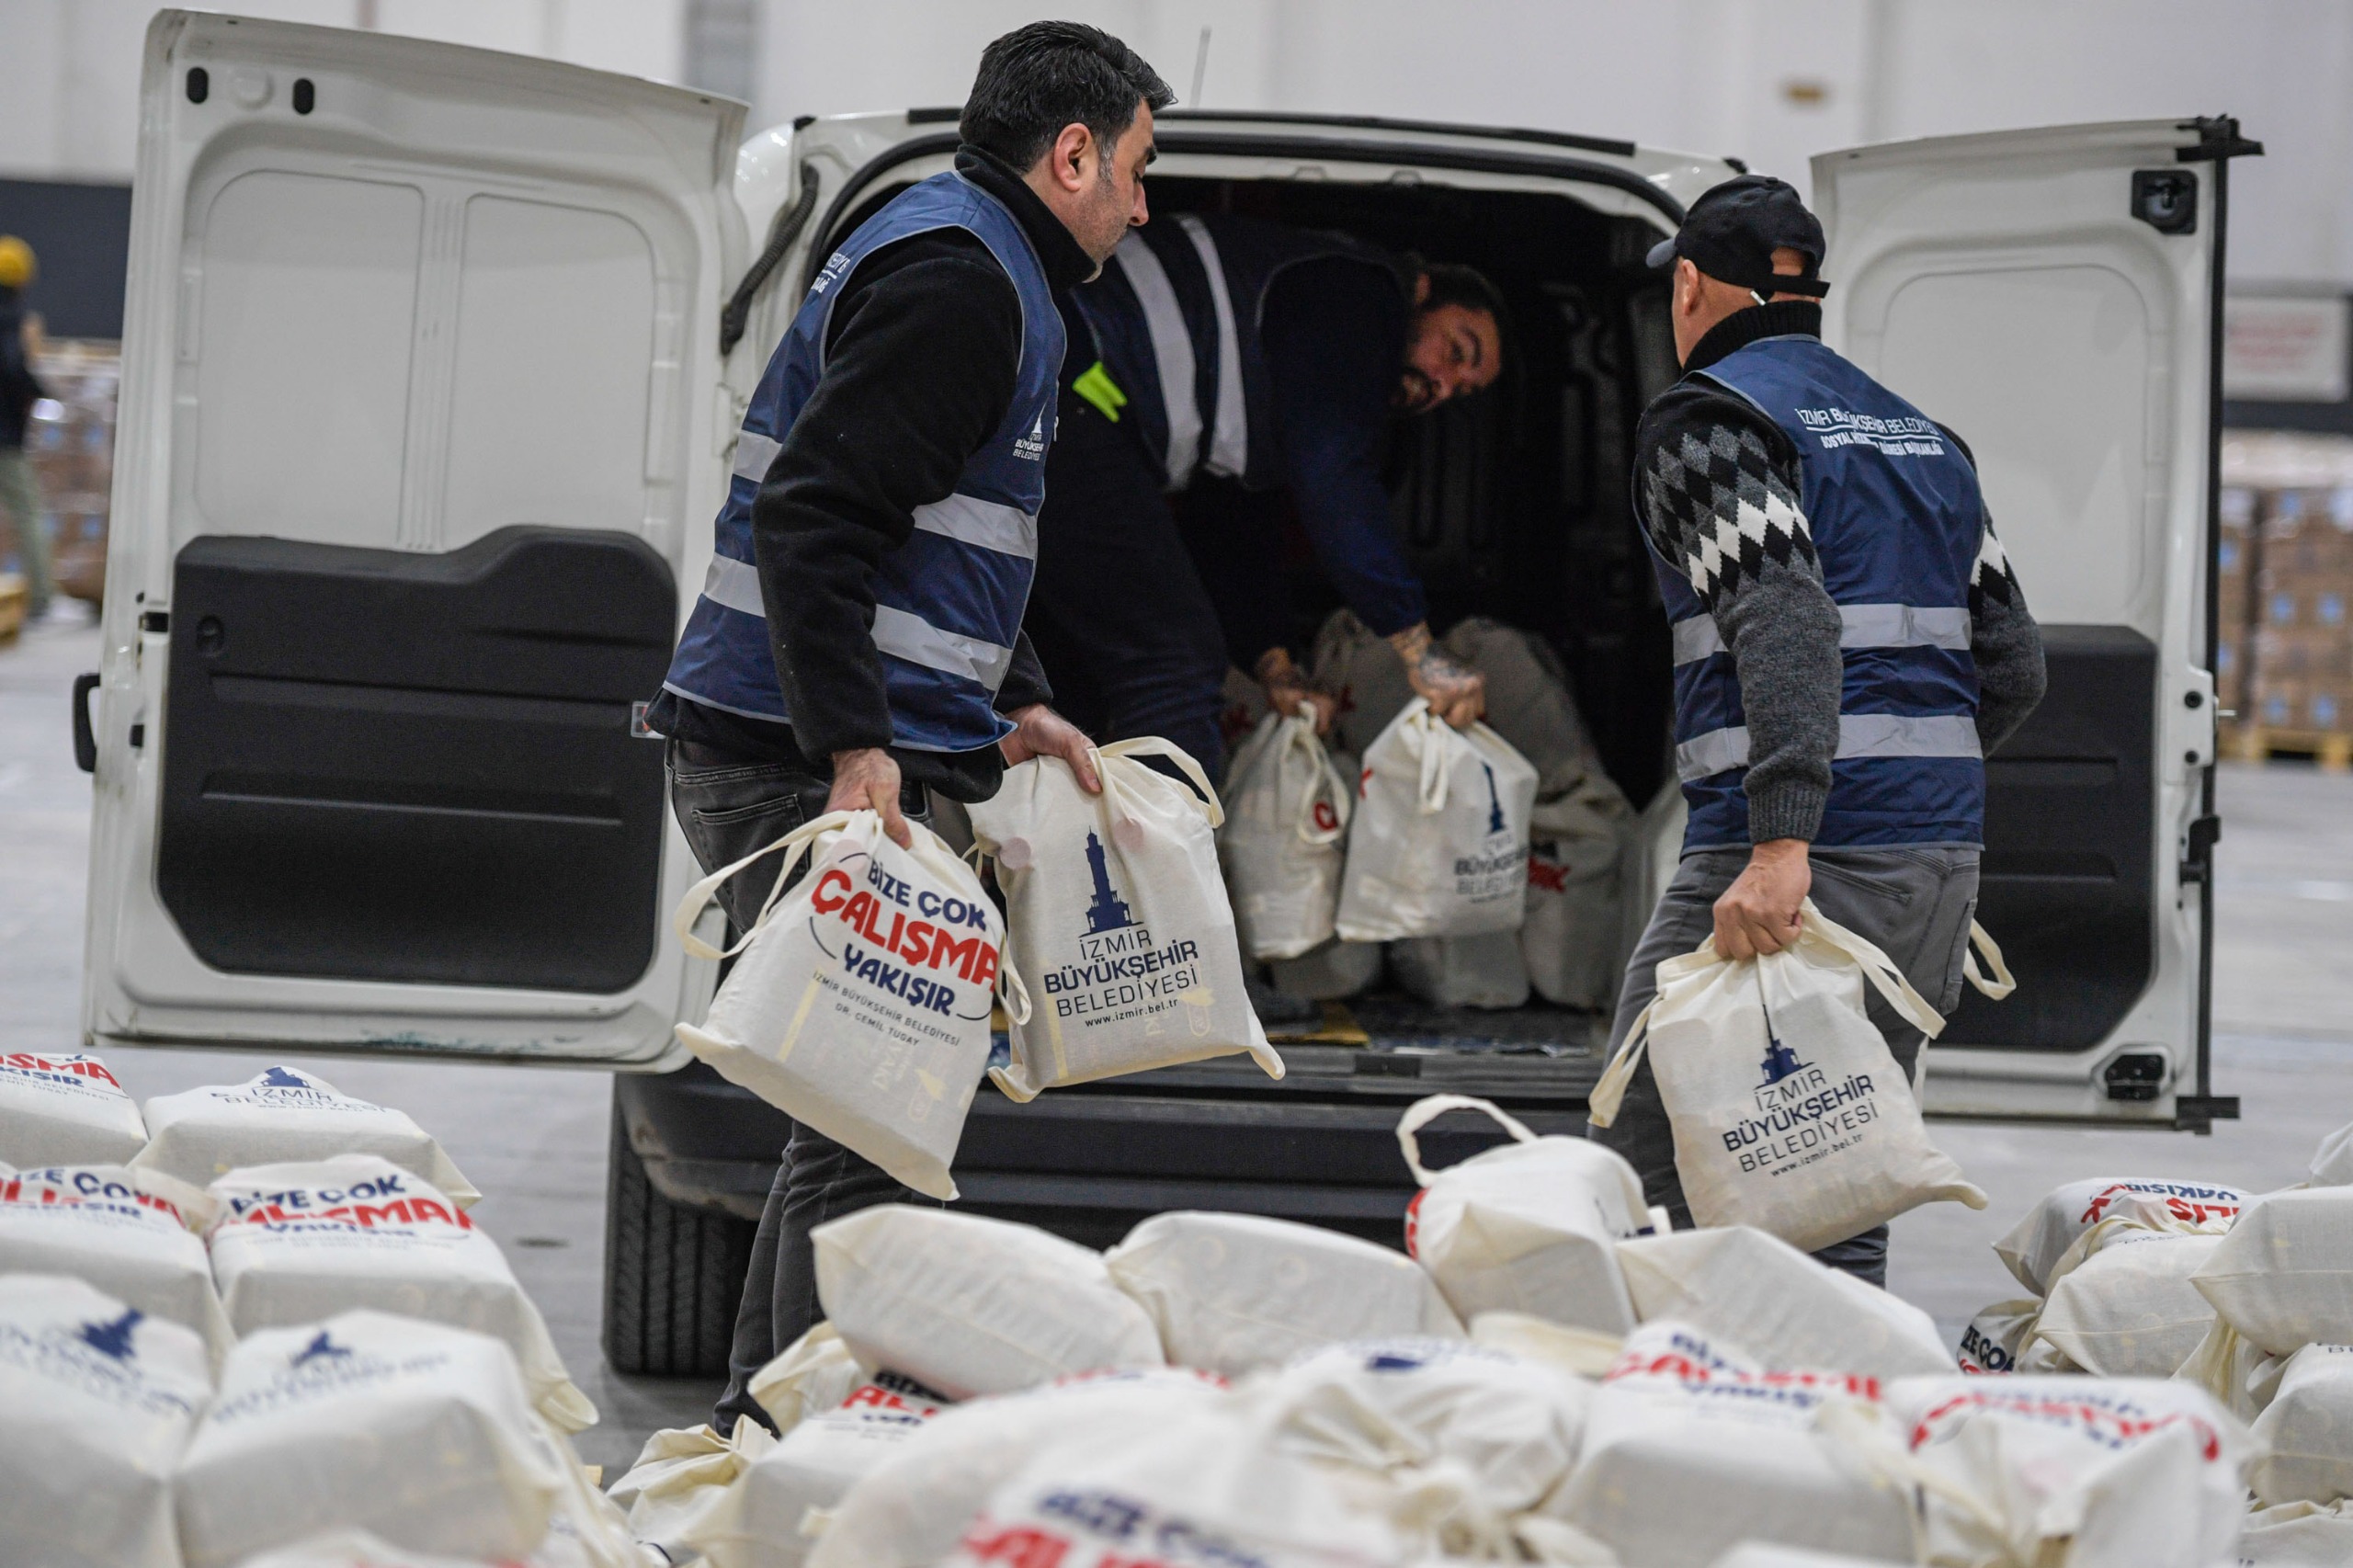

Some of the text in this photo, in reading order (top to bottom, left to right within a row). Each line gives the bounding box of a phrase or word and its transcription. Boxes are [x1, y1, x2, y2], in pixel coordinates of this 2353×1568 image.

[1794, 408, 1832, 426] İZMİR
[868, 859, 987, 932] BİZE ÇOK
[1043, 939, 1199, 994] BÜYÜKŞEHİR
[1079, 928, 1153, 960] İZMİR
[845, 943, 956, 1017] YAKIŞIR
[1056, 964, 1198, 1017] BELEDİYESİ
[813, 970, 839, 992] İZMİR
[904, 1017, 961, 1047] BELEDİYESİ
[854, 1012, 885, 1032] CEMİL
[888, 1026, 920, 1047] TUGAY
[1085, 997, 1178, 1028] www.izmir.bel.tr
[1722, 1074, 1875, 1152] BÜYÜKŞEHİR
[1754, 1069, 1827, 1111] İZMİR
[1739, 1098, 1879, 1173] BELEDİYESİ
[1770, 1133, 1863, 1176] www.izmir.bel.tr
